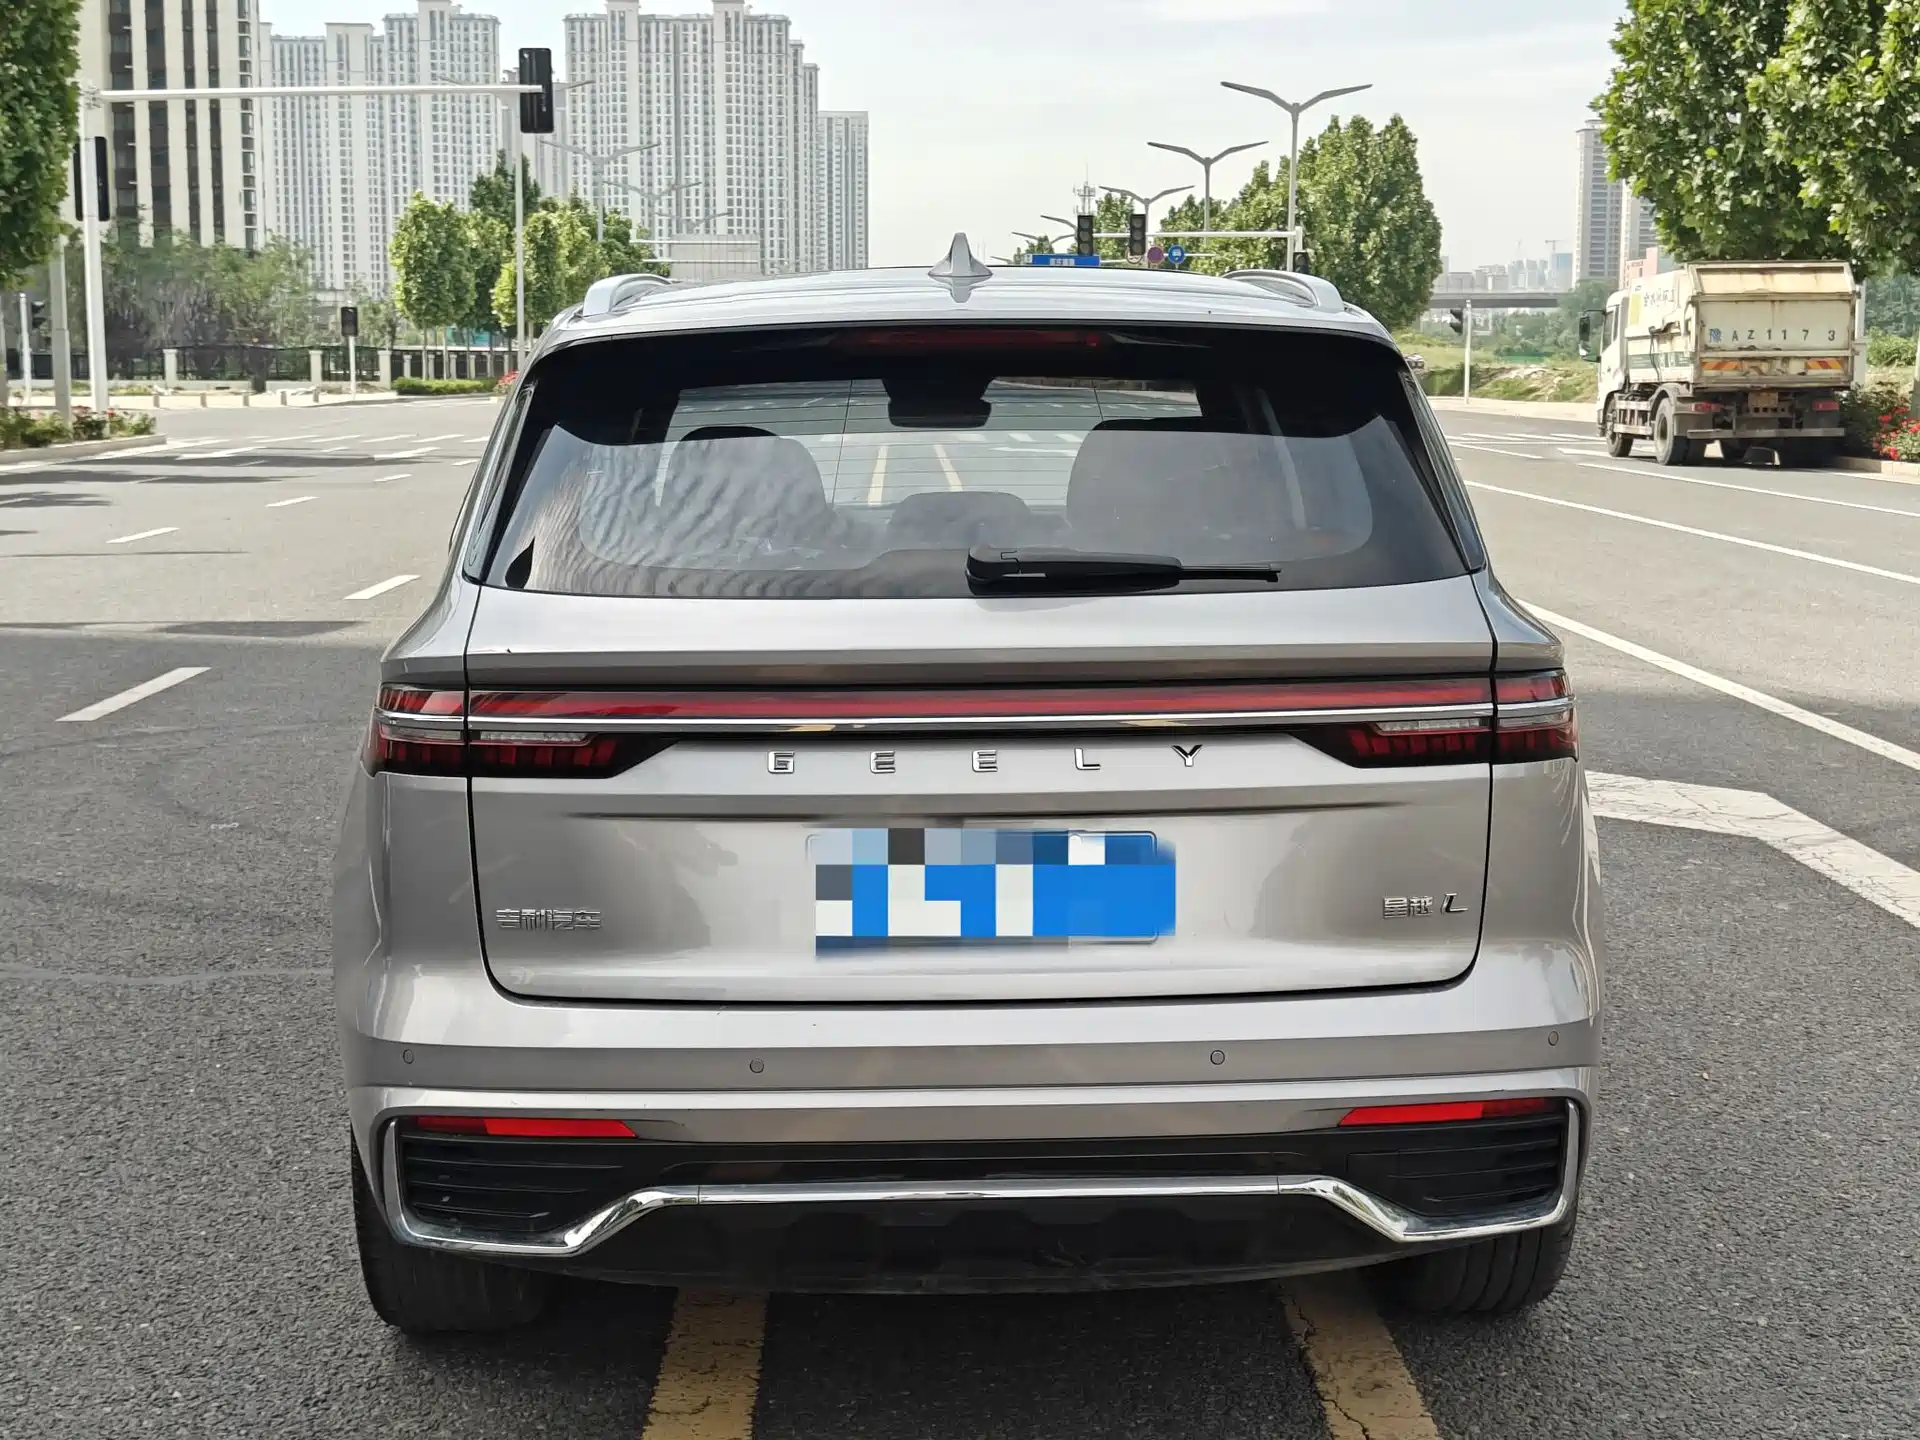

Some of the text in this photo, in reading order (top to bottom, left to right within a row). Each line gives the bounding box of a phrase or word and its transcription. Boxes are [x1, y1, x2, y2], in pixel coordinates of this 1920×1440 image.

[767, 744, 1203, 775] GEELY
[495, 907, 602, 931] 吉利汽车
